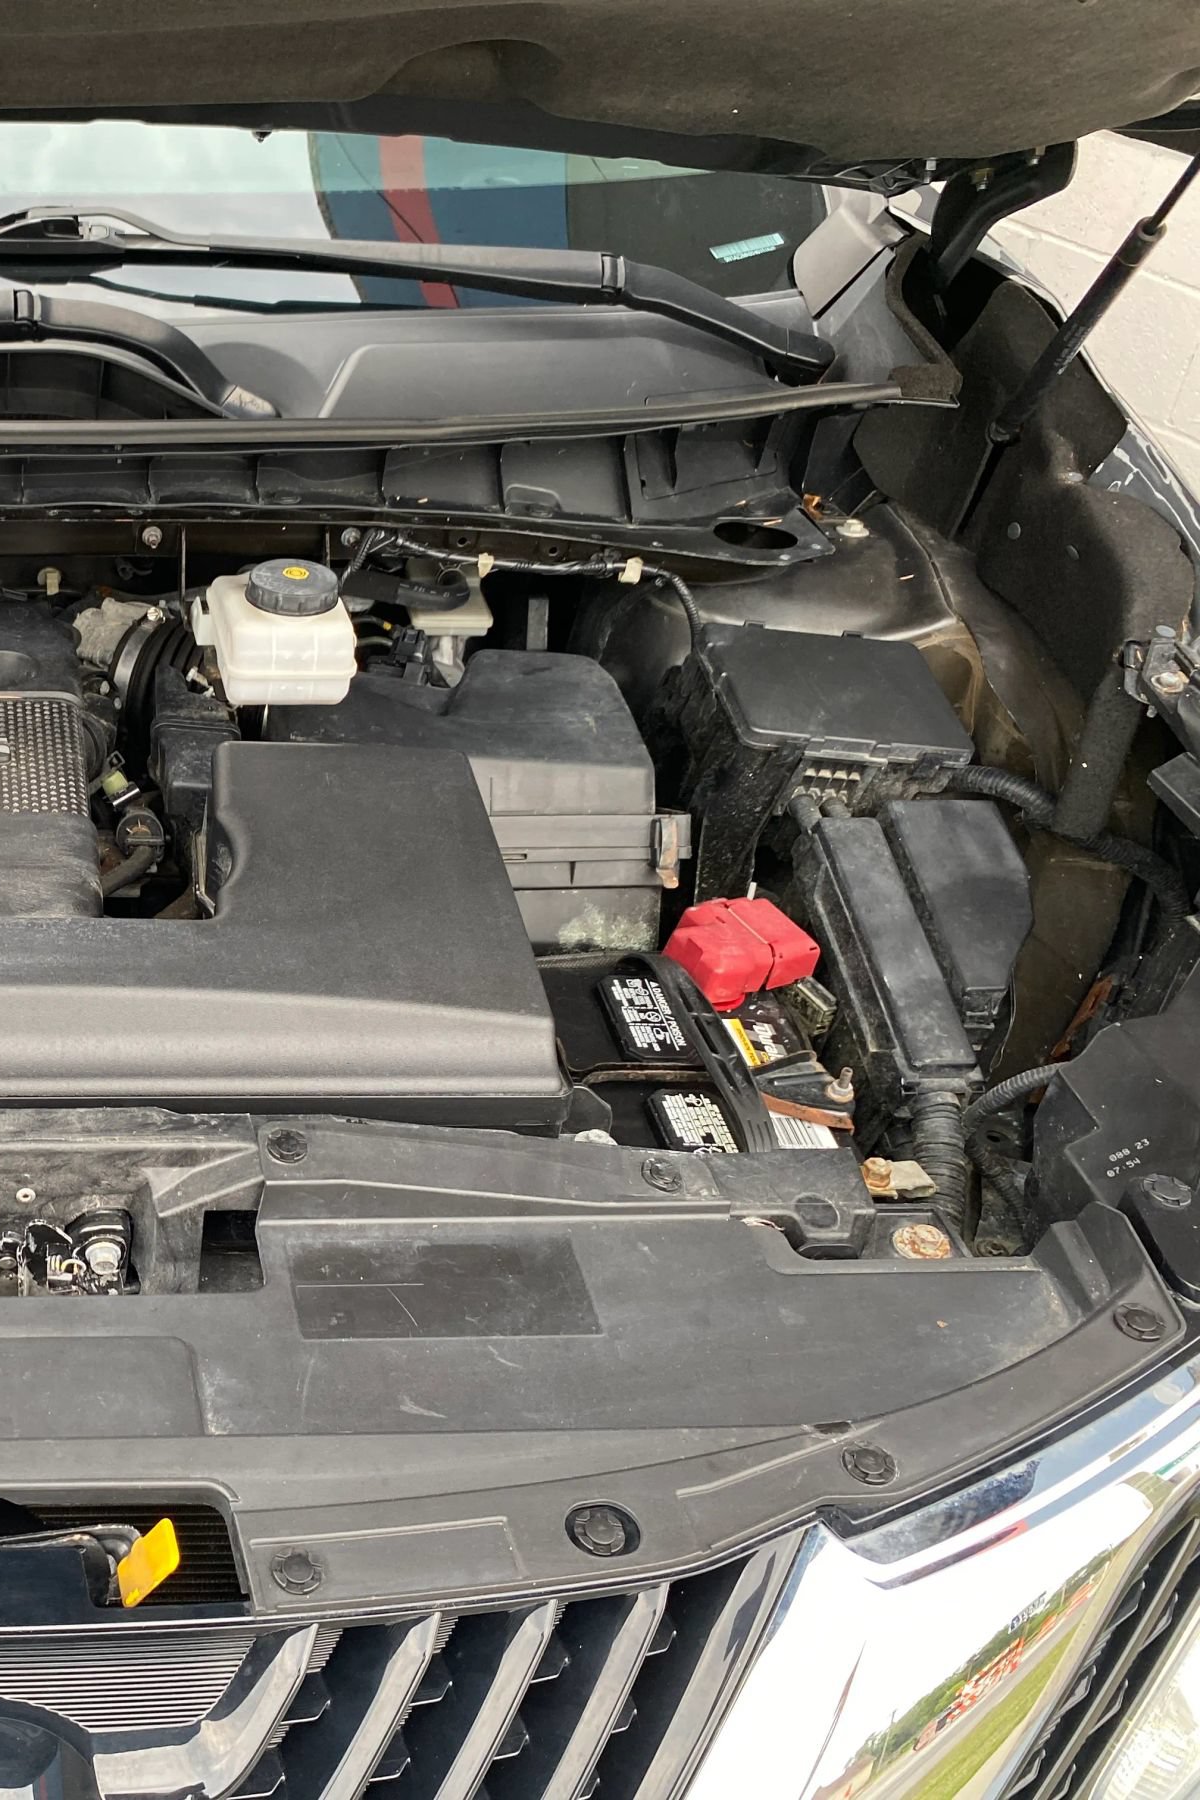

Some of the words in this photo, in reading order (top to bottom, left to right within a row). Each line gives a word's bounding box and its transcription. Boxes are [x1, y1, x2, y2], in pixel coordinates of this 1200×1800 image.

[652, 988, 672, 1015] DANGER
[667, 1020, 687, 1046] POISON
[752, 1023, 785, 1060] Dural
[1134, 1138, 1150, 1150] 23
